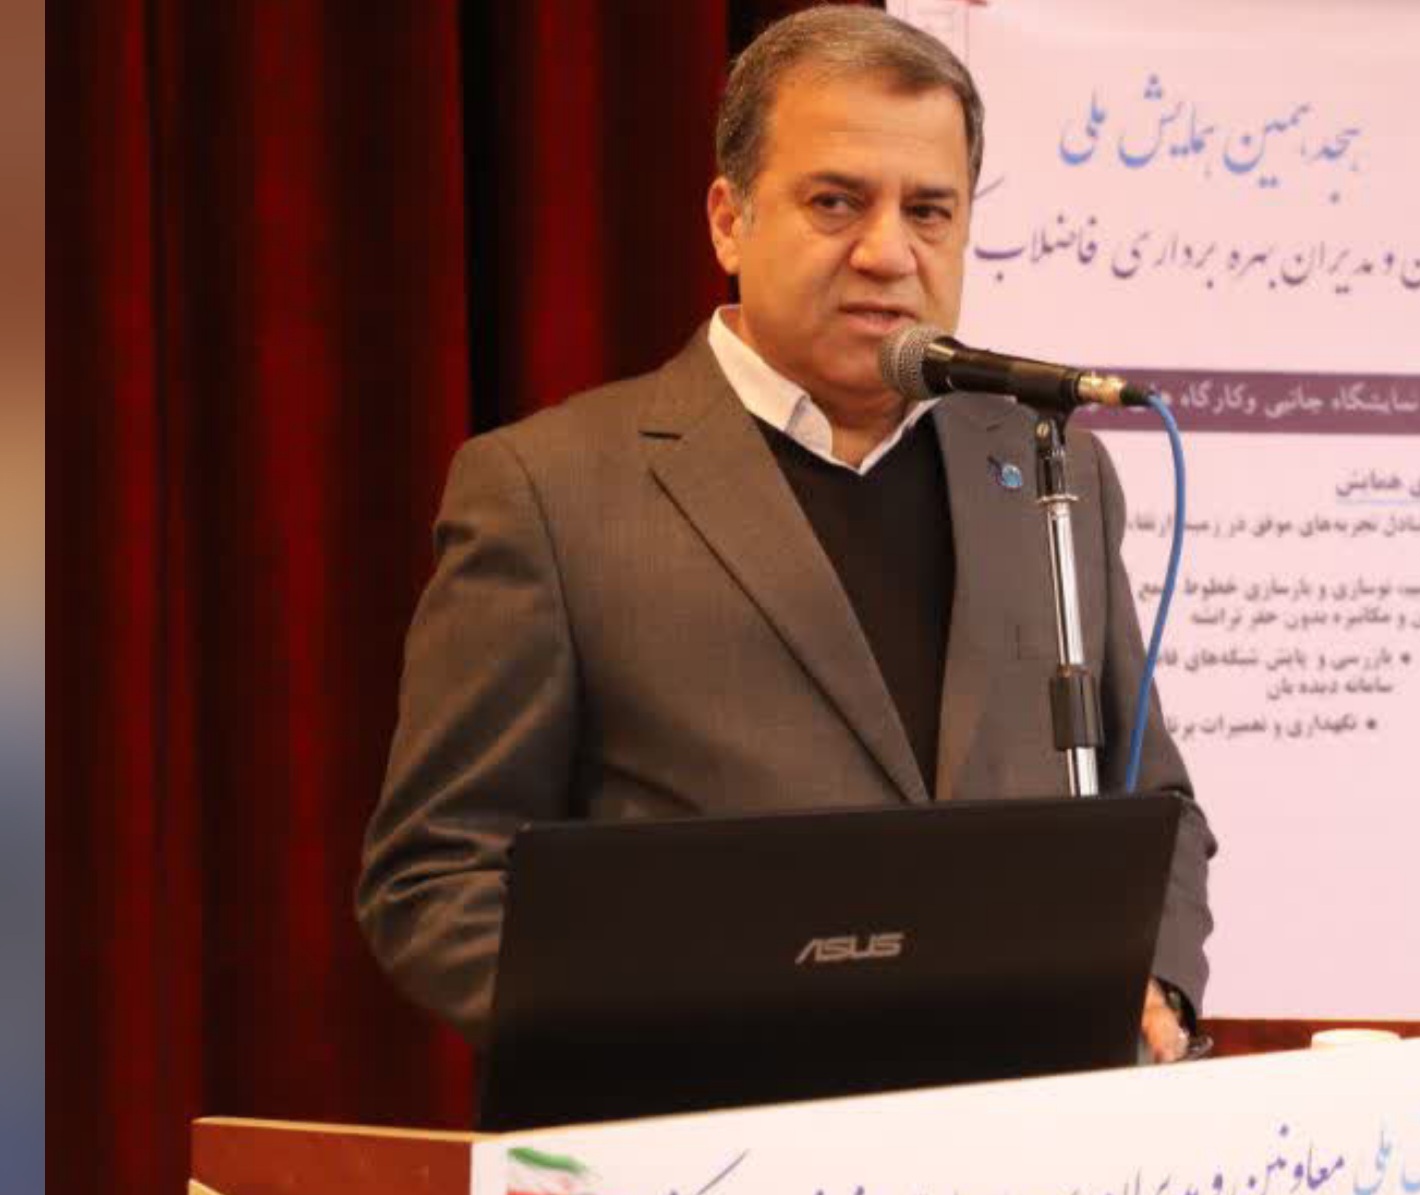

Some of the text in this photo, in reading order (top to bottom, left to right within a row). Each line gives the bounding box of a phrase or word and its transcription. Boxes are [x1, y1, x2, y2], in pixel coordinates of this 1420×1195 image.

[1059, 87, 1106, 166] ملی
[1117, 73, 1214, 177] همایش
[972, 213, 1098, 282] فاضلاب
[1110, 230, 1215, 290] برداری
[1226, 247, 1276, 289] بهره
[1280, 239, 1376, 294] مدیران
[1382, 250, 1396, 274] و
[1265, 390, 1323, 420] جانبی
[1335, 467, 1401, 498] همایش
[795, 932, 905, 965] ASUS
